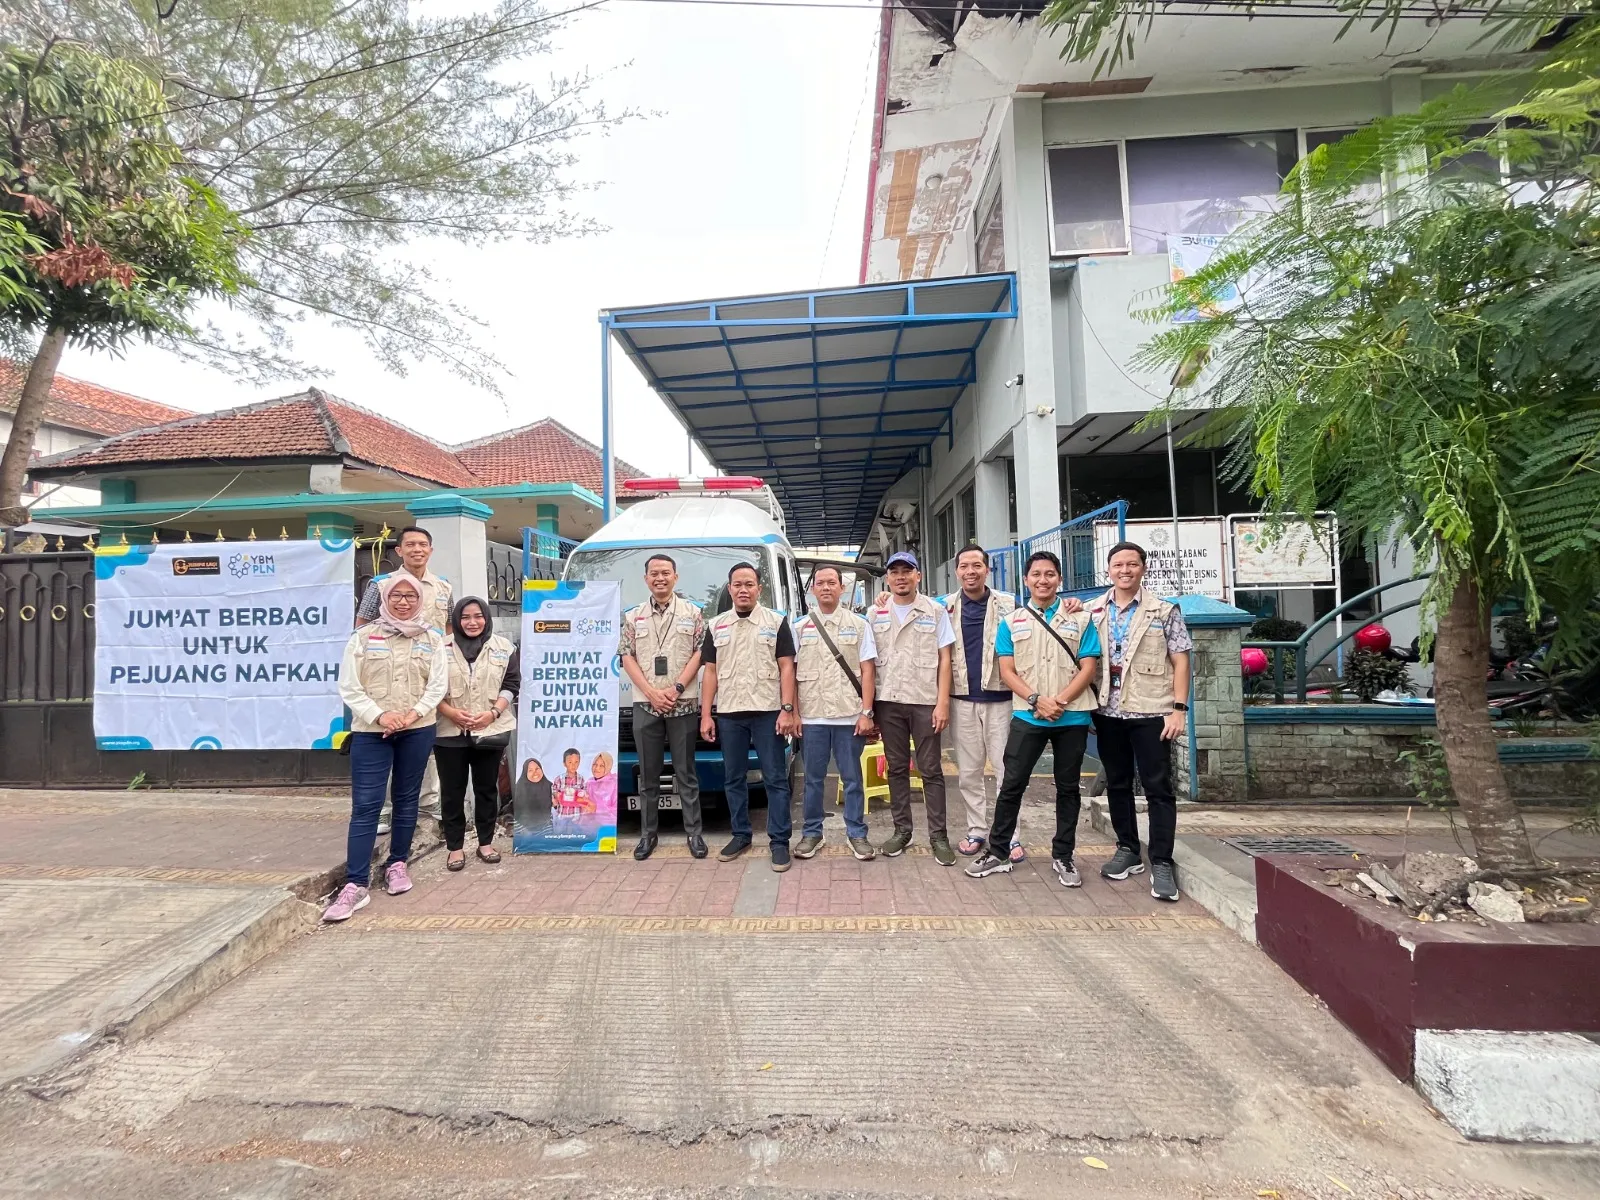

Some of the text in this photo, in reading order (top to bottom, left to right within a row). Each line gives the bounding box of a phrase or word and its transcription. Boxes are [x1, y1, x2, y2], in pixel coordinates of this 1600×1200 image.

[251, 555, 274, 564] YBM
[1146, 549, 1208, 559] IMPINAN CABANG
[253, 565, 275, 574] PLN
[1194, 569, 1218, 579] BISNIS
[123, 606, 328, 628] JUM'AT BERBAGI
[183, 635, 269, 655] UNTUK
[541, 651, 602, 664] JUM'AT
[110, 663, 340, 684] PEJUANG NAFKAH
[533, 667, 608, 680] BERBAGI
[543, 683, 598, 696] UNTUK
[531, 699, 608, 712] PEJUANG
[535, 714, 603, 729] NAFKAH
[630, 796, 672, 809] B 35
